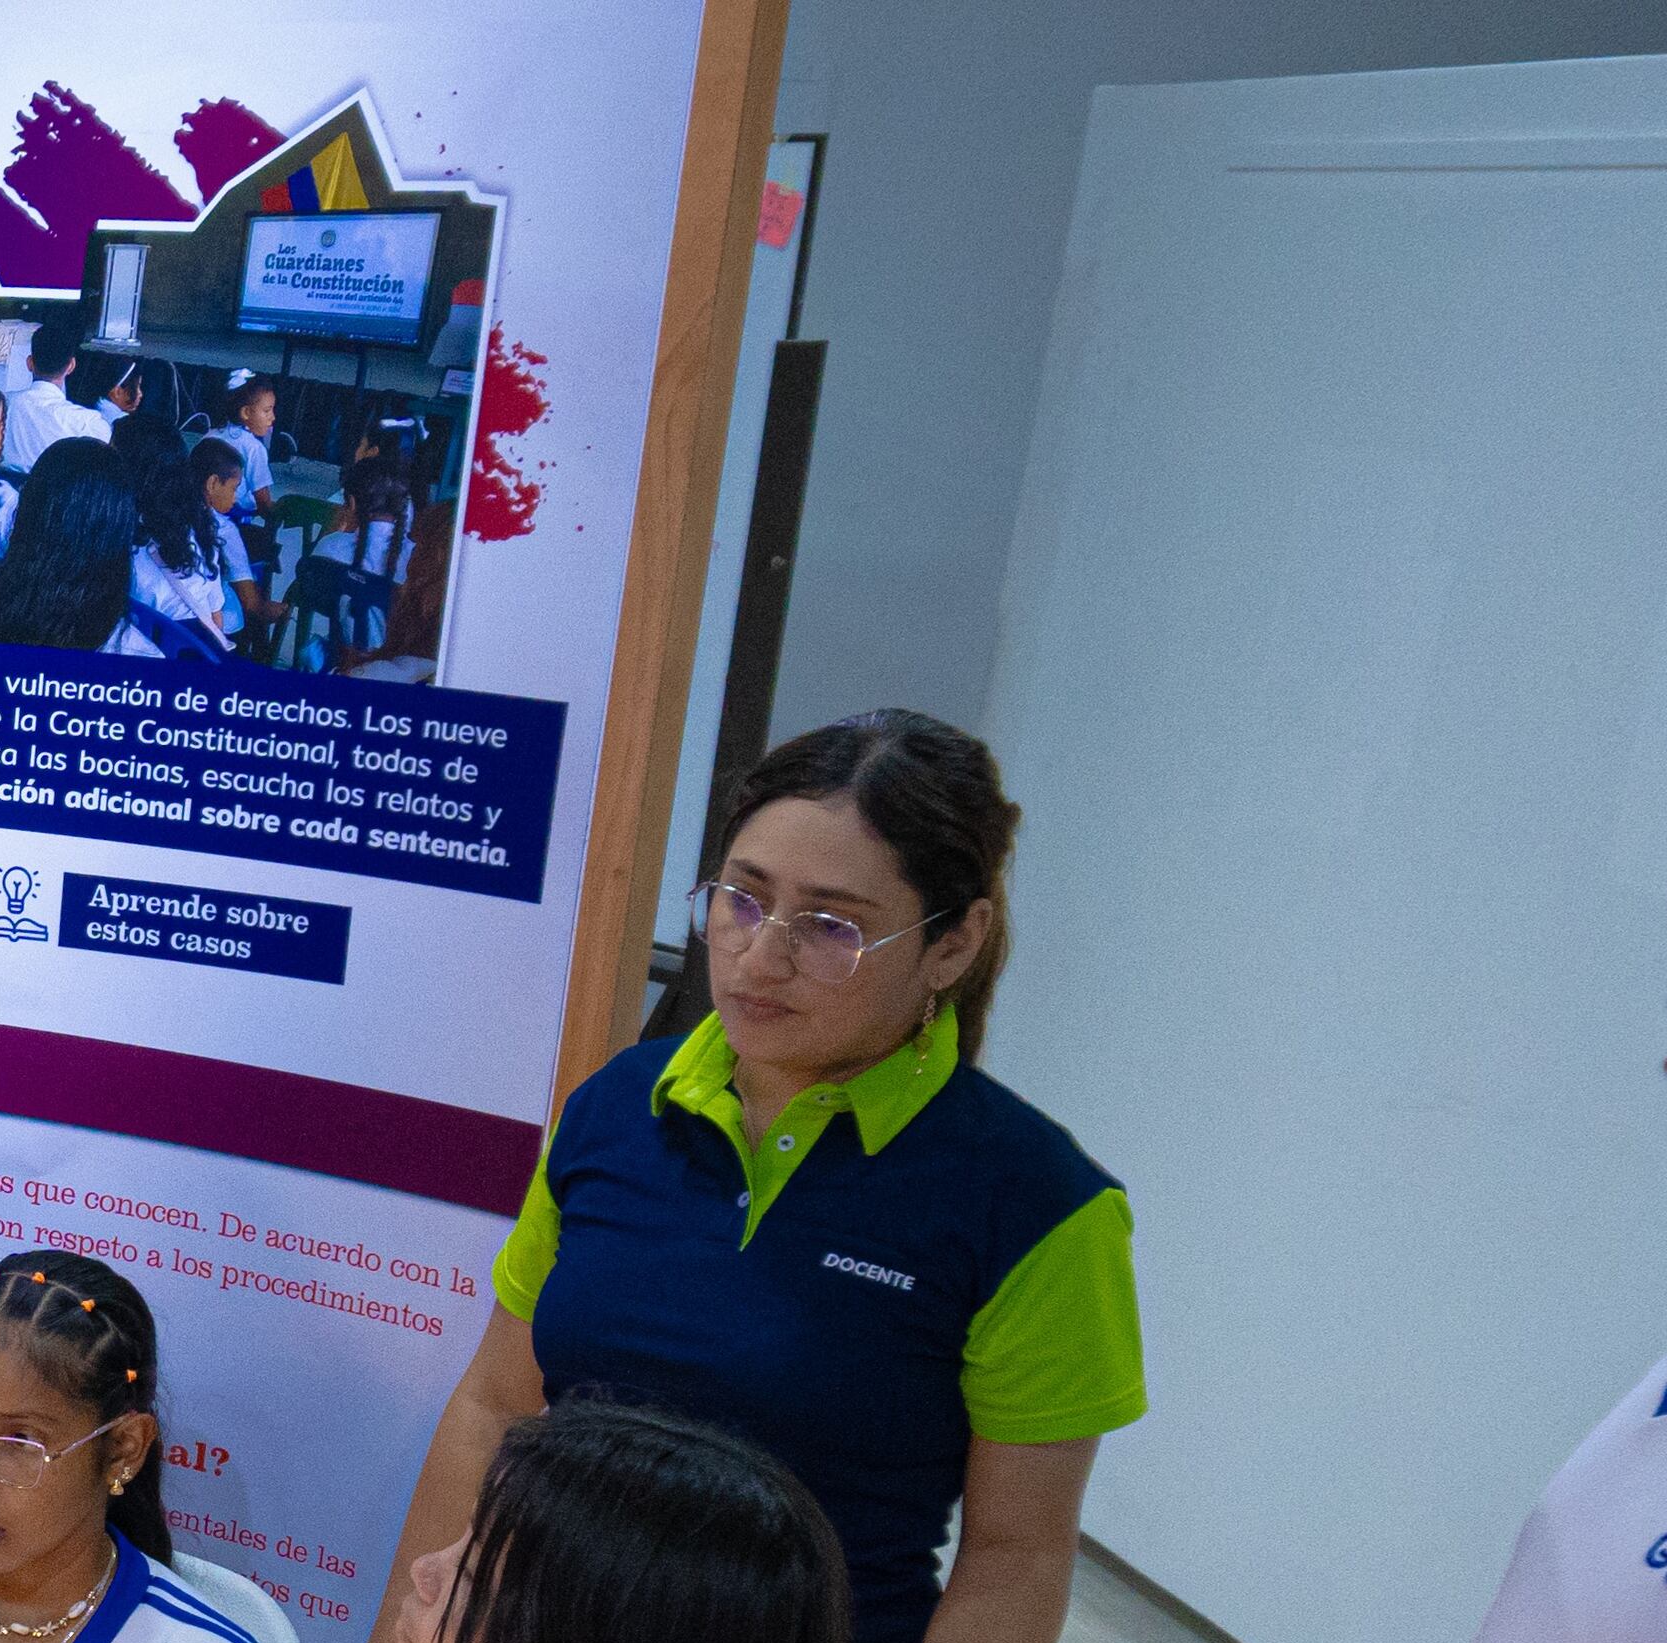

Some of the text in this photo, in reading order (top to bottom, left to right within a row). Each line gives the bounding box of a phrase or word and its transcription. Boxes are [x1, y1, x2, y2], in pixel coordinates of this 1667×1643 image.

[265, 253, 365, 272] Guardianes
[278, 243, 297, 255] Los
[262, 272, 404, 294] de la Constitución
[5, 673, 162, 707] vulneración
[174, 687, 208, 713] de
[220, 692, 351, 728] derechos.
[364, 707, 412, 736] Los
[423, 720, 507, 748] nueve
[64, 788, 192, 821] adicional
[200, 804, 280, 833] sobre
[290, 817, 358, 843] cada
[368, 829, 508, 865] sentencia.
[89, 884, 309, 933] Aprende sobre
[86, 922, 251, 959] estos casos
[24, 1181, 76, 1205] que
[84, 1192, 206, 1232] conocen.
[219, 1212, 256, 1242] De
[265, 1230, 381, 1271] acuerdo
[390, 1259, 439, 1287] con
[822, 1252, 916, 1291] DOCENTE
